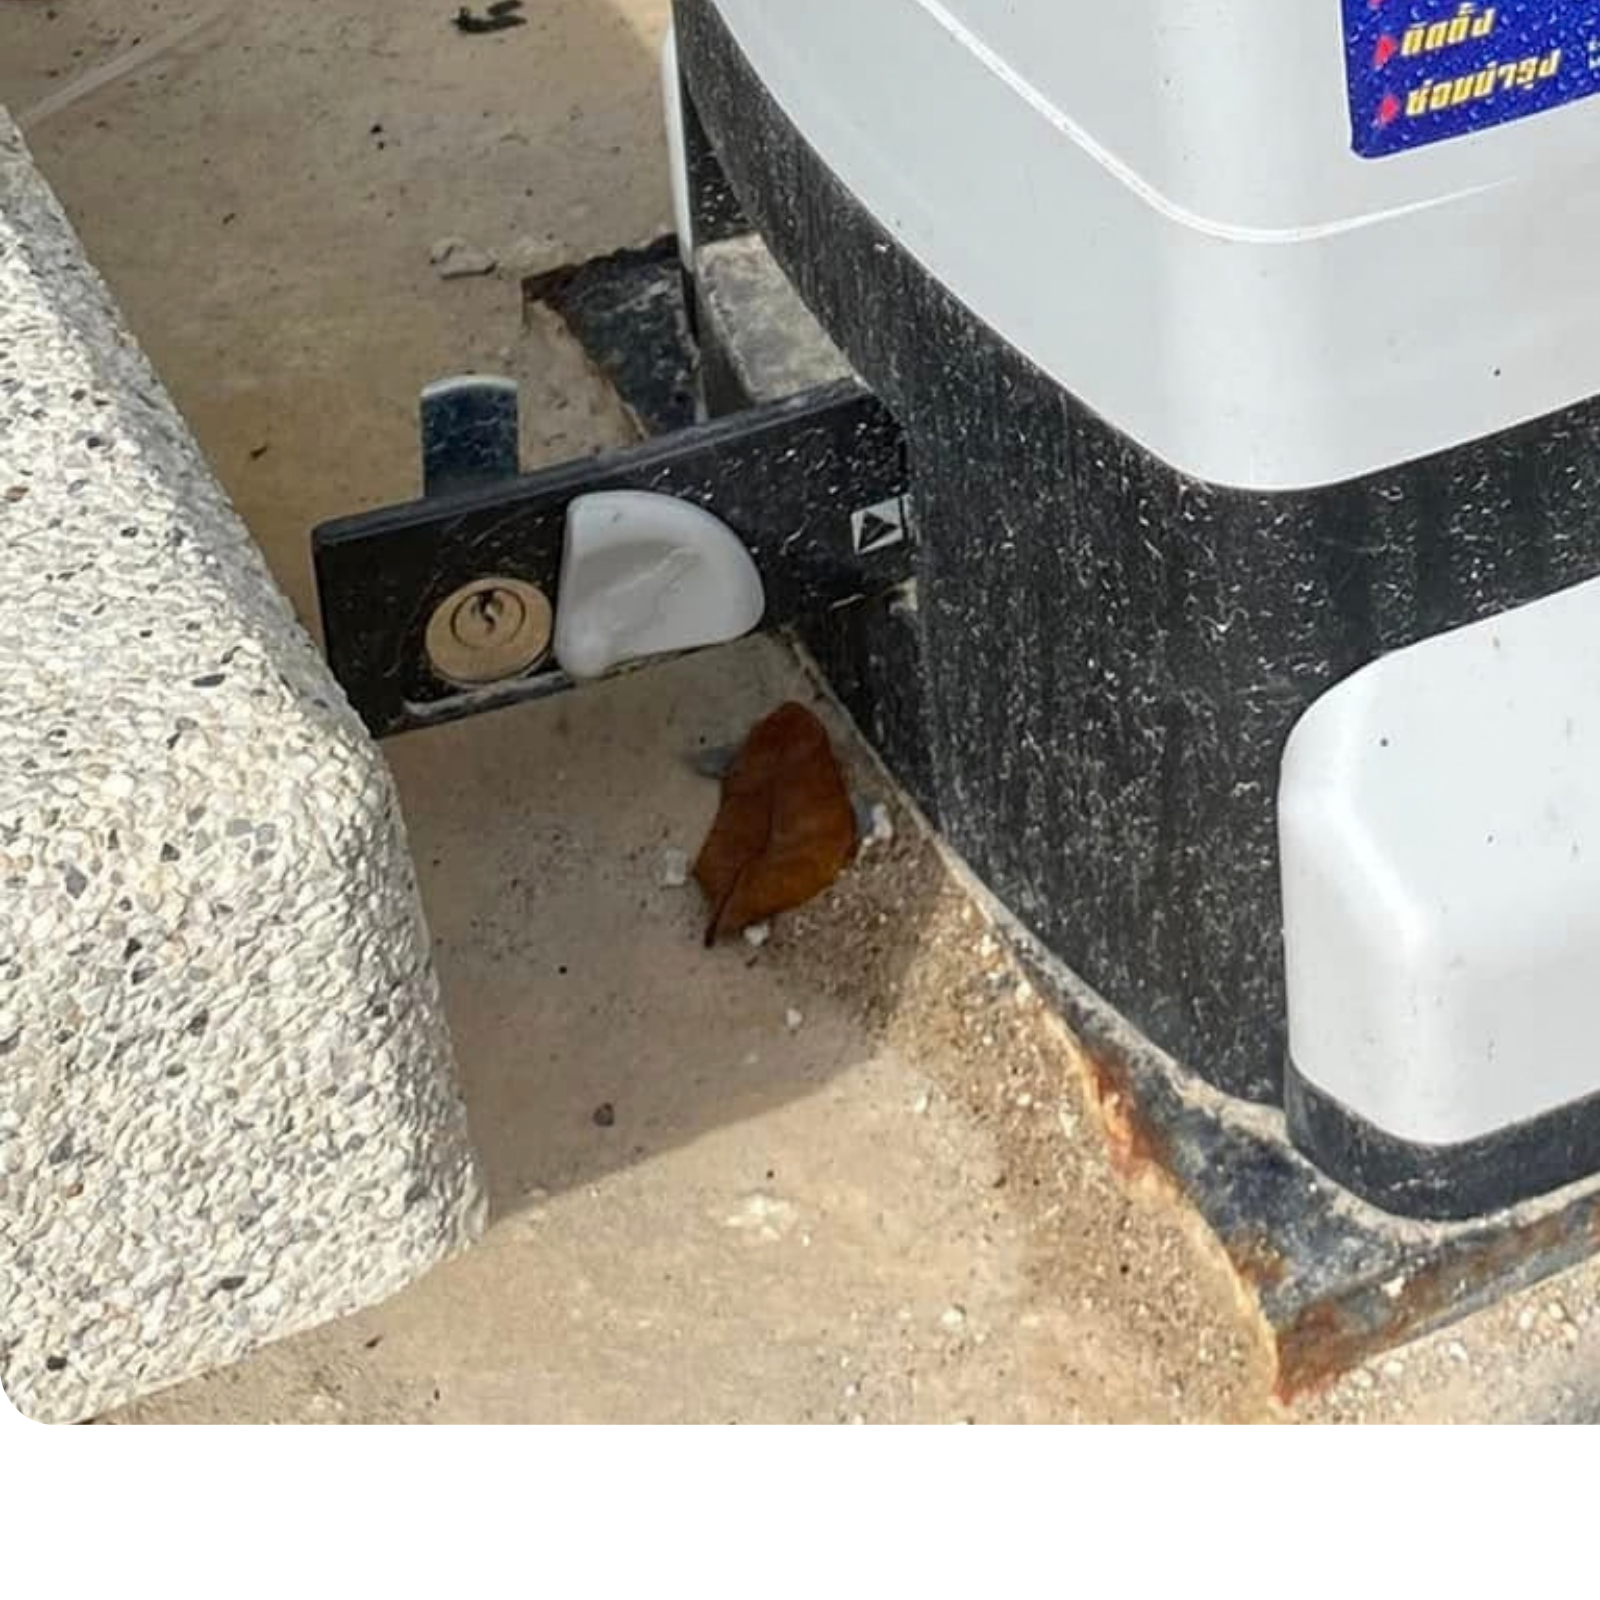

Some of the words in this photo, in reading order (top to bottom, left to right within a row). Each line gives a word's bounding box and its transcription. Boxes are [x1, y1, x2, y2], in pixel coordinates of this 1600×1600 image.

[1401, 1, 1495, 56] ติดตั้ง
[1406, 48, 1560, 115] ซ่อมบำรุง
